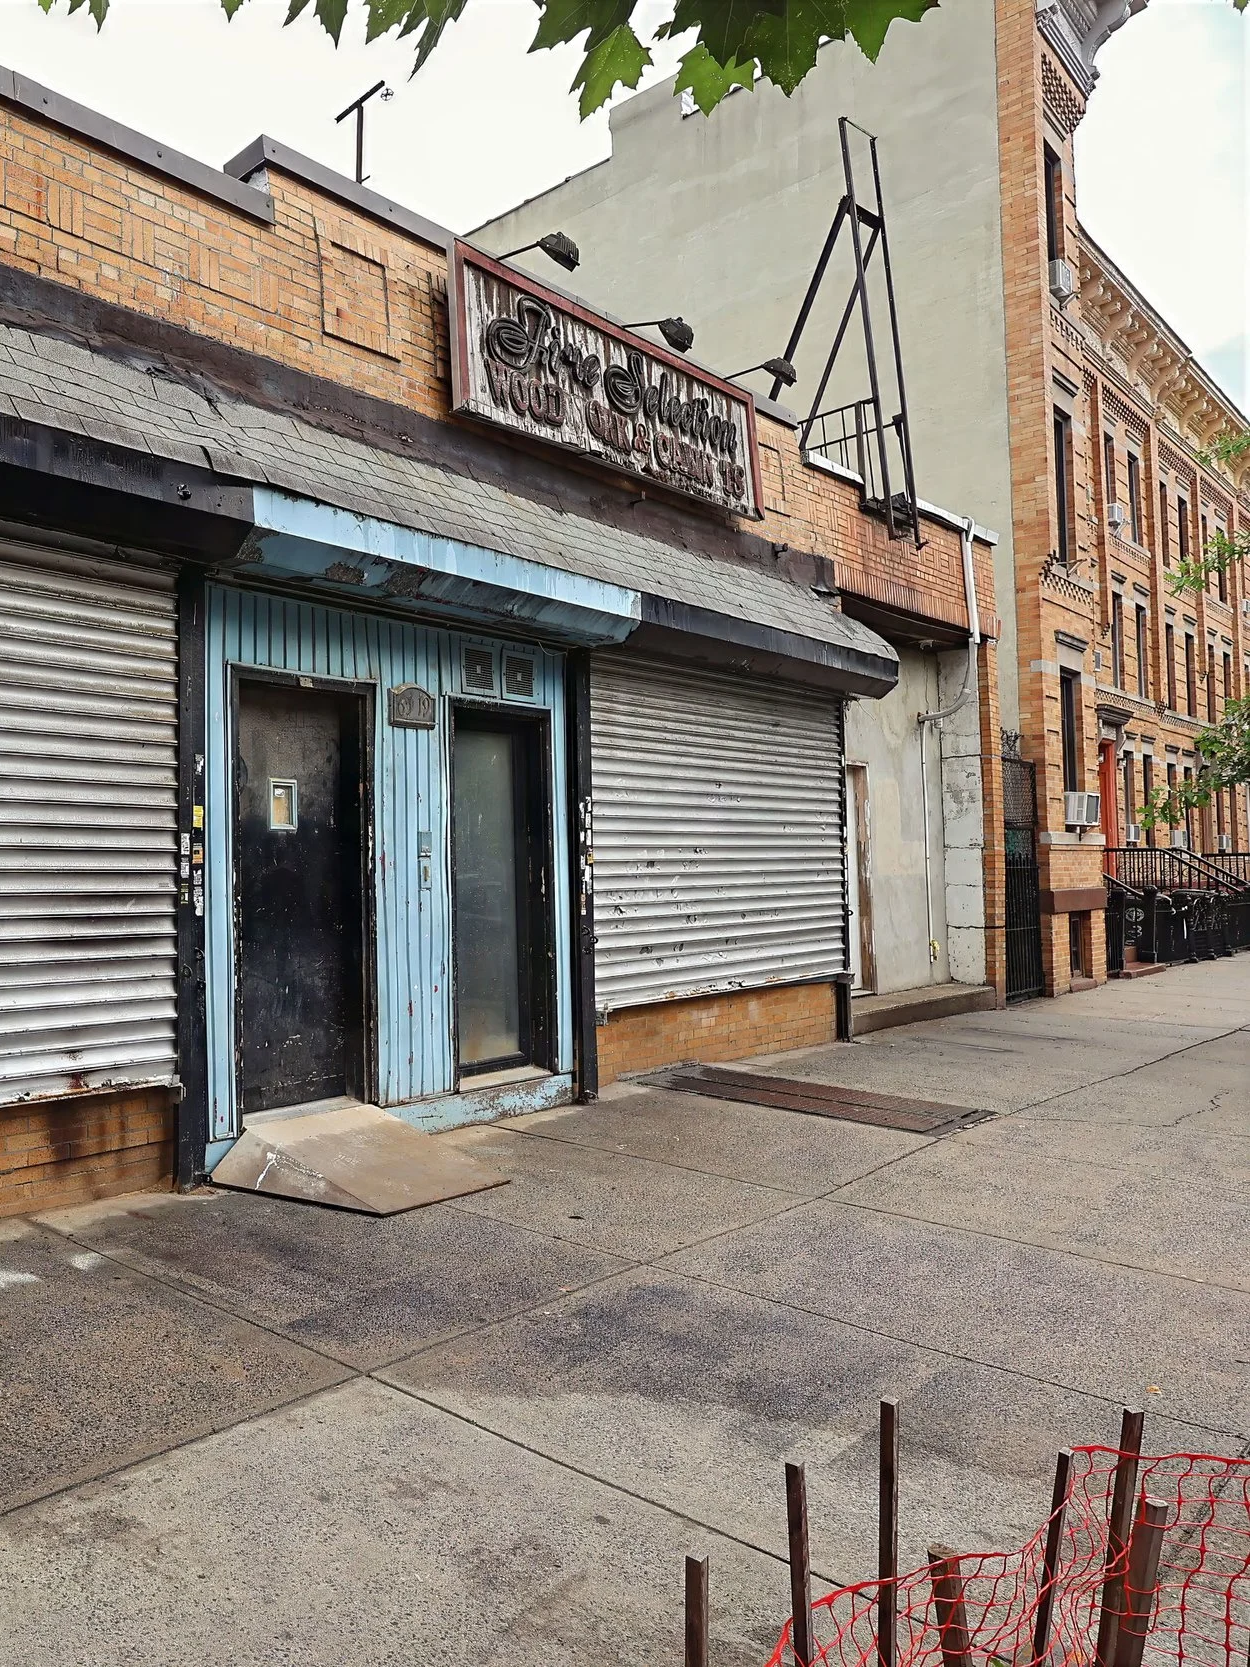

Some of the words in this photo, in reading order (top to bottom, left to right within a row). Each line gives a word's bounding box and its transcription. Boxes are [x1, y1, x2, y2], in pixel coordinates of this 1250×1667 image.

[485, 358, 566, 427] WOOD
[486, 294, 600, 388] Fine
[604, 351, 738, 453] Selection
